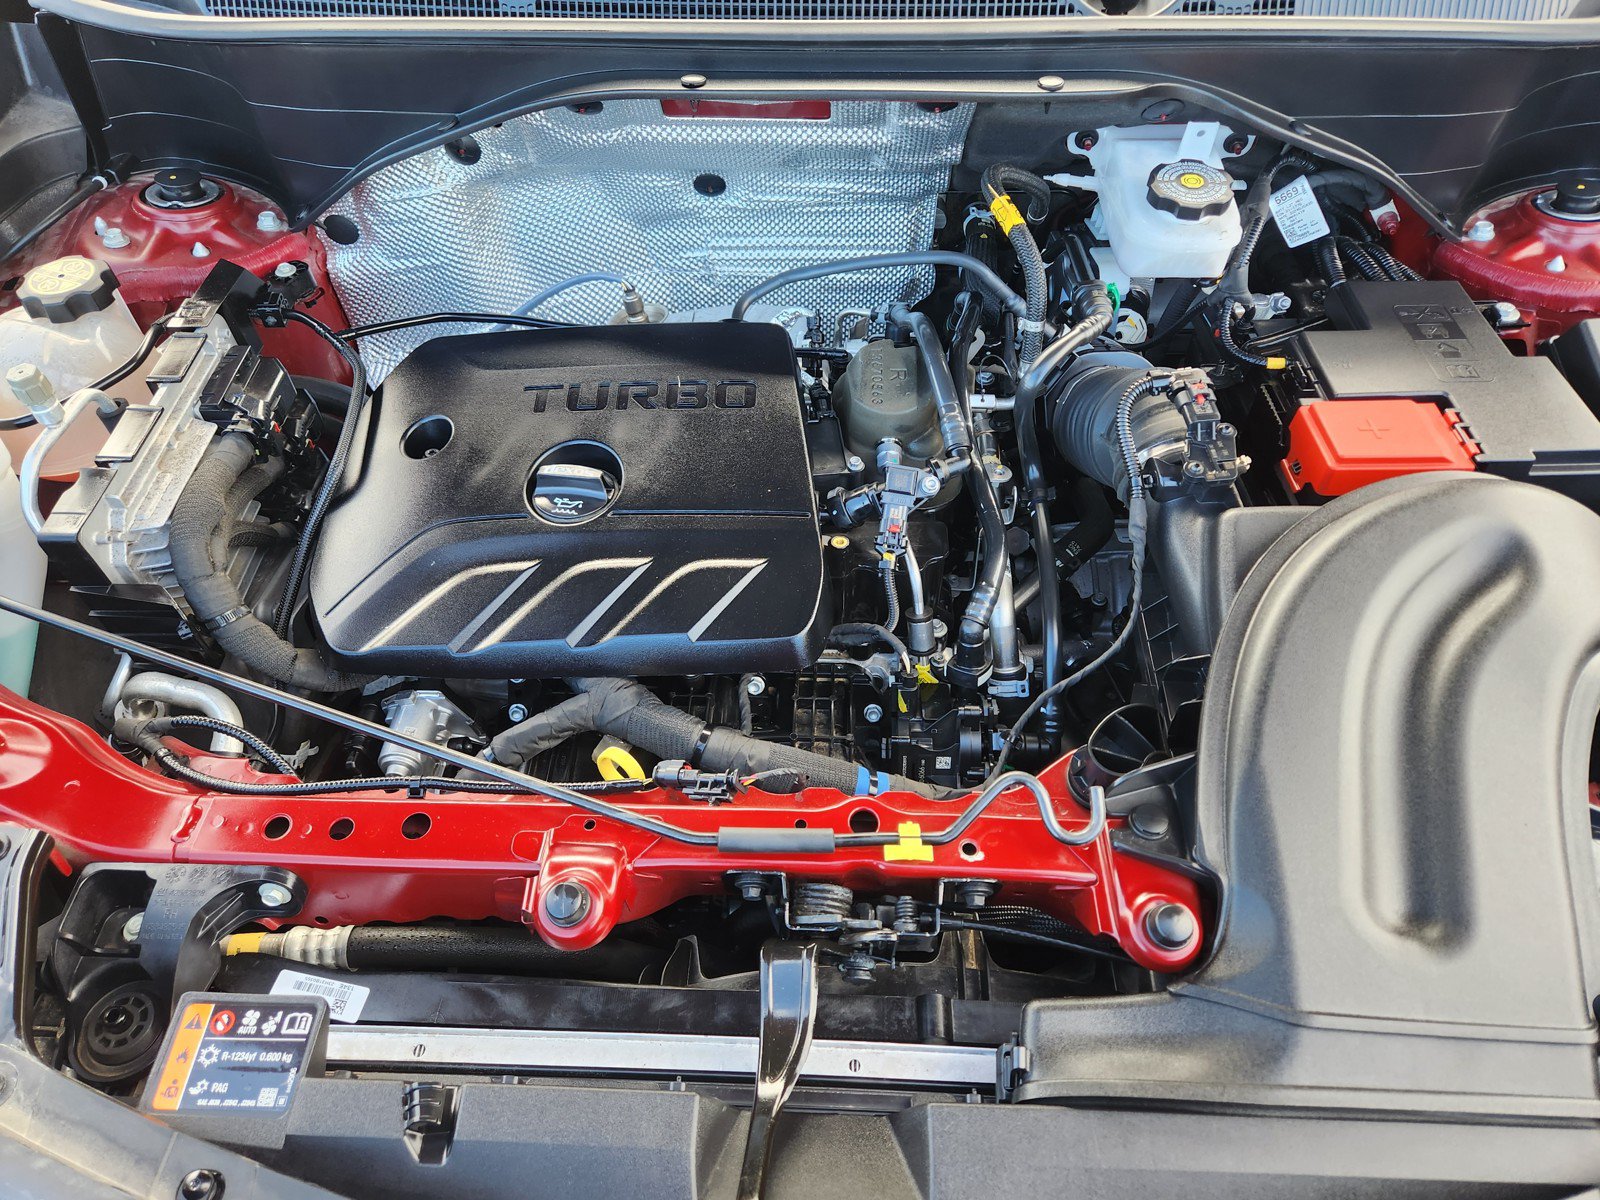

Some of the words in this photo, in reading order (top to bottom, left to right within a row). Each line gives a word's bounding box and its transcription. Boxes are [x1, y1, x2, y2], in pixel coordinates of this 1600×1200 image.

[1274, 186, 1300, 205] 6669
[523, 380, 757, 413] TURBO
[237, 1026, 257, 1034] AUTO
[221, 1051, 257, 1063] R-1234yf
[259, 1051, 281, 1062] 0.600
[281, 1052, 293, 1064] kg
[211, 1082, 229, 1093] PAG
